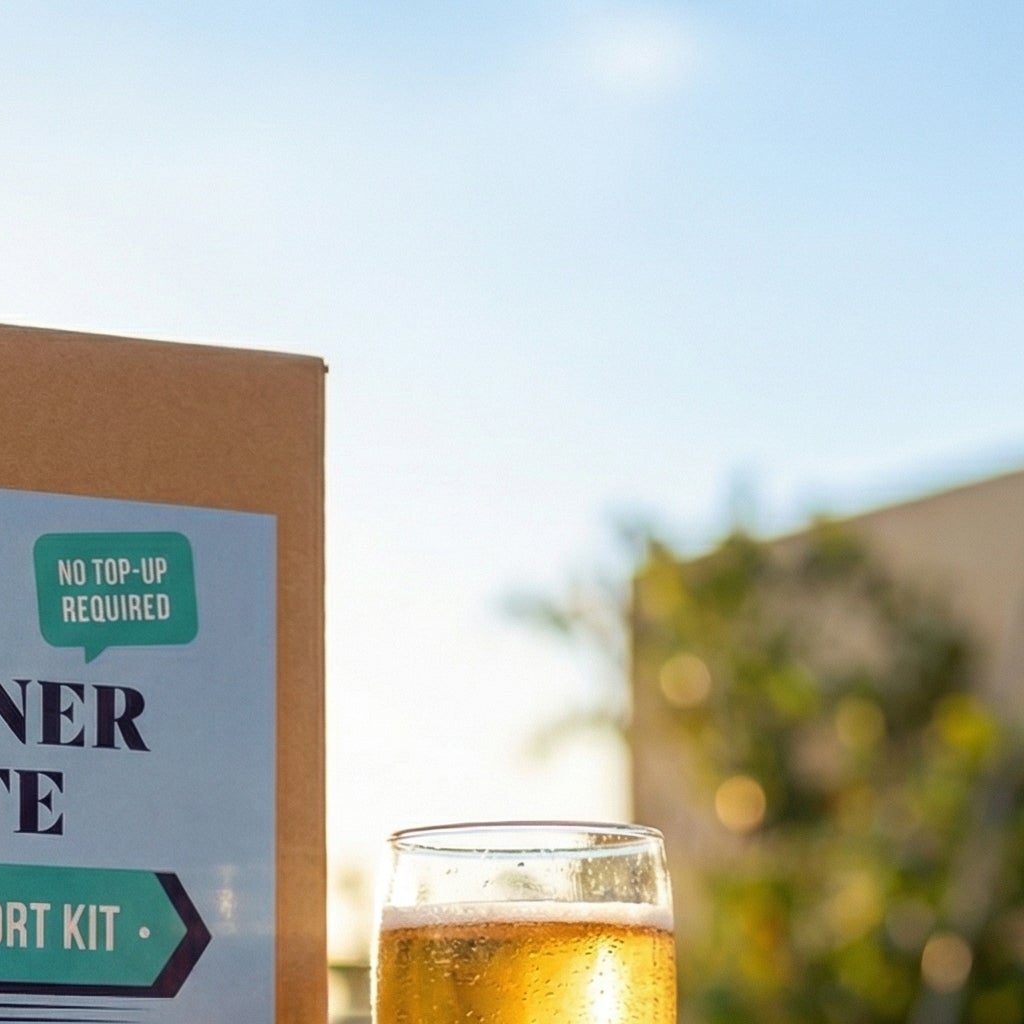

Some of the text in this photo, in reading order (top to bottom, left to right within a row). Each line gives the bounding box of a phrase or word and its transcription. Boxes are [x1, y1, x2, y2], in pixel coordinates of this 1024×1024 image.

[58, 557, 168, 586] NO TOP-UP
[62, 593, 171, 623] REQUIRED
[63, 903, 121, 952] KIT
